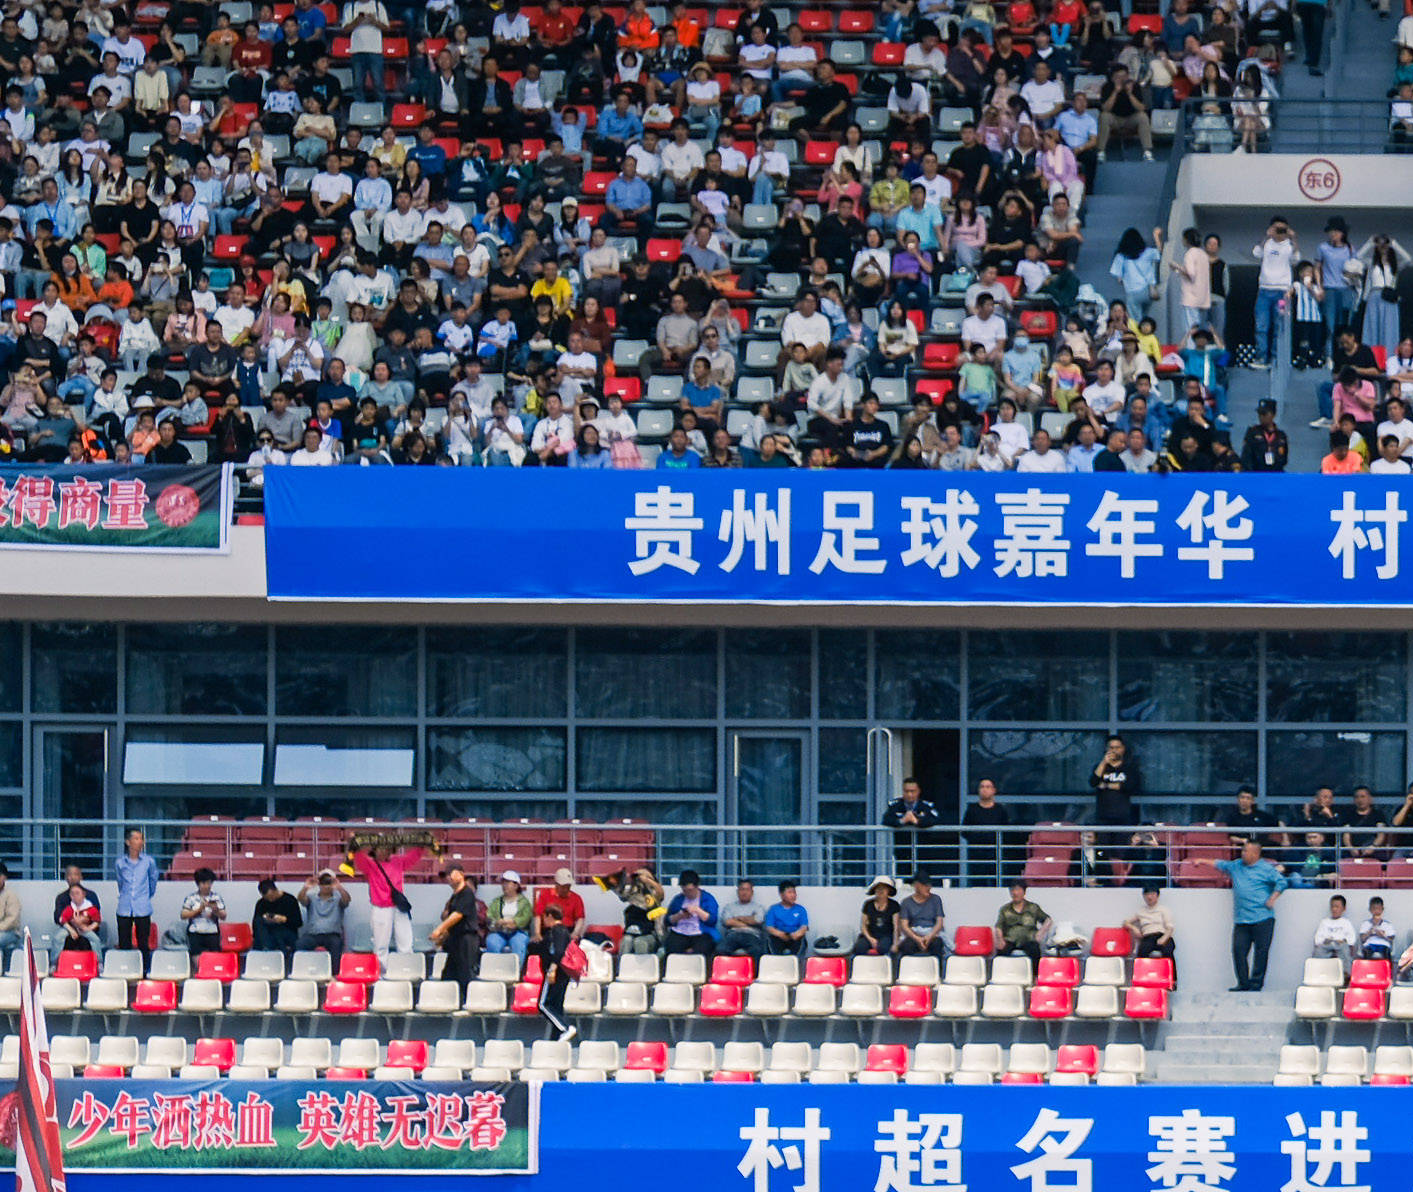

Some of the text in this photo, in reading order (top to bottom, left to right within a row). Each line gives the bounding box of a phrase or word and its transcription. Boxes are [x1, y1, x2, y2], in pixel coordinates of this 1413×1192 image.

[0, 474, 150, 531] 得商量
[624, 486, 1254, 580] 贵州足球嘉年华
[66, 1090, 507, 1151] 少年洒热血 英雄无迟暮
